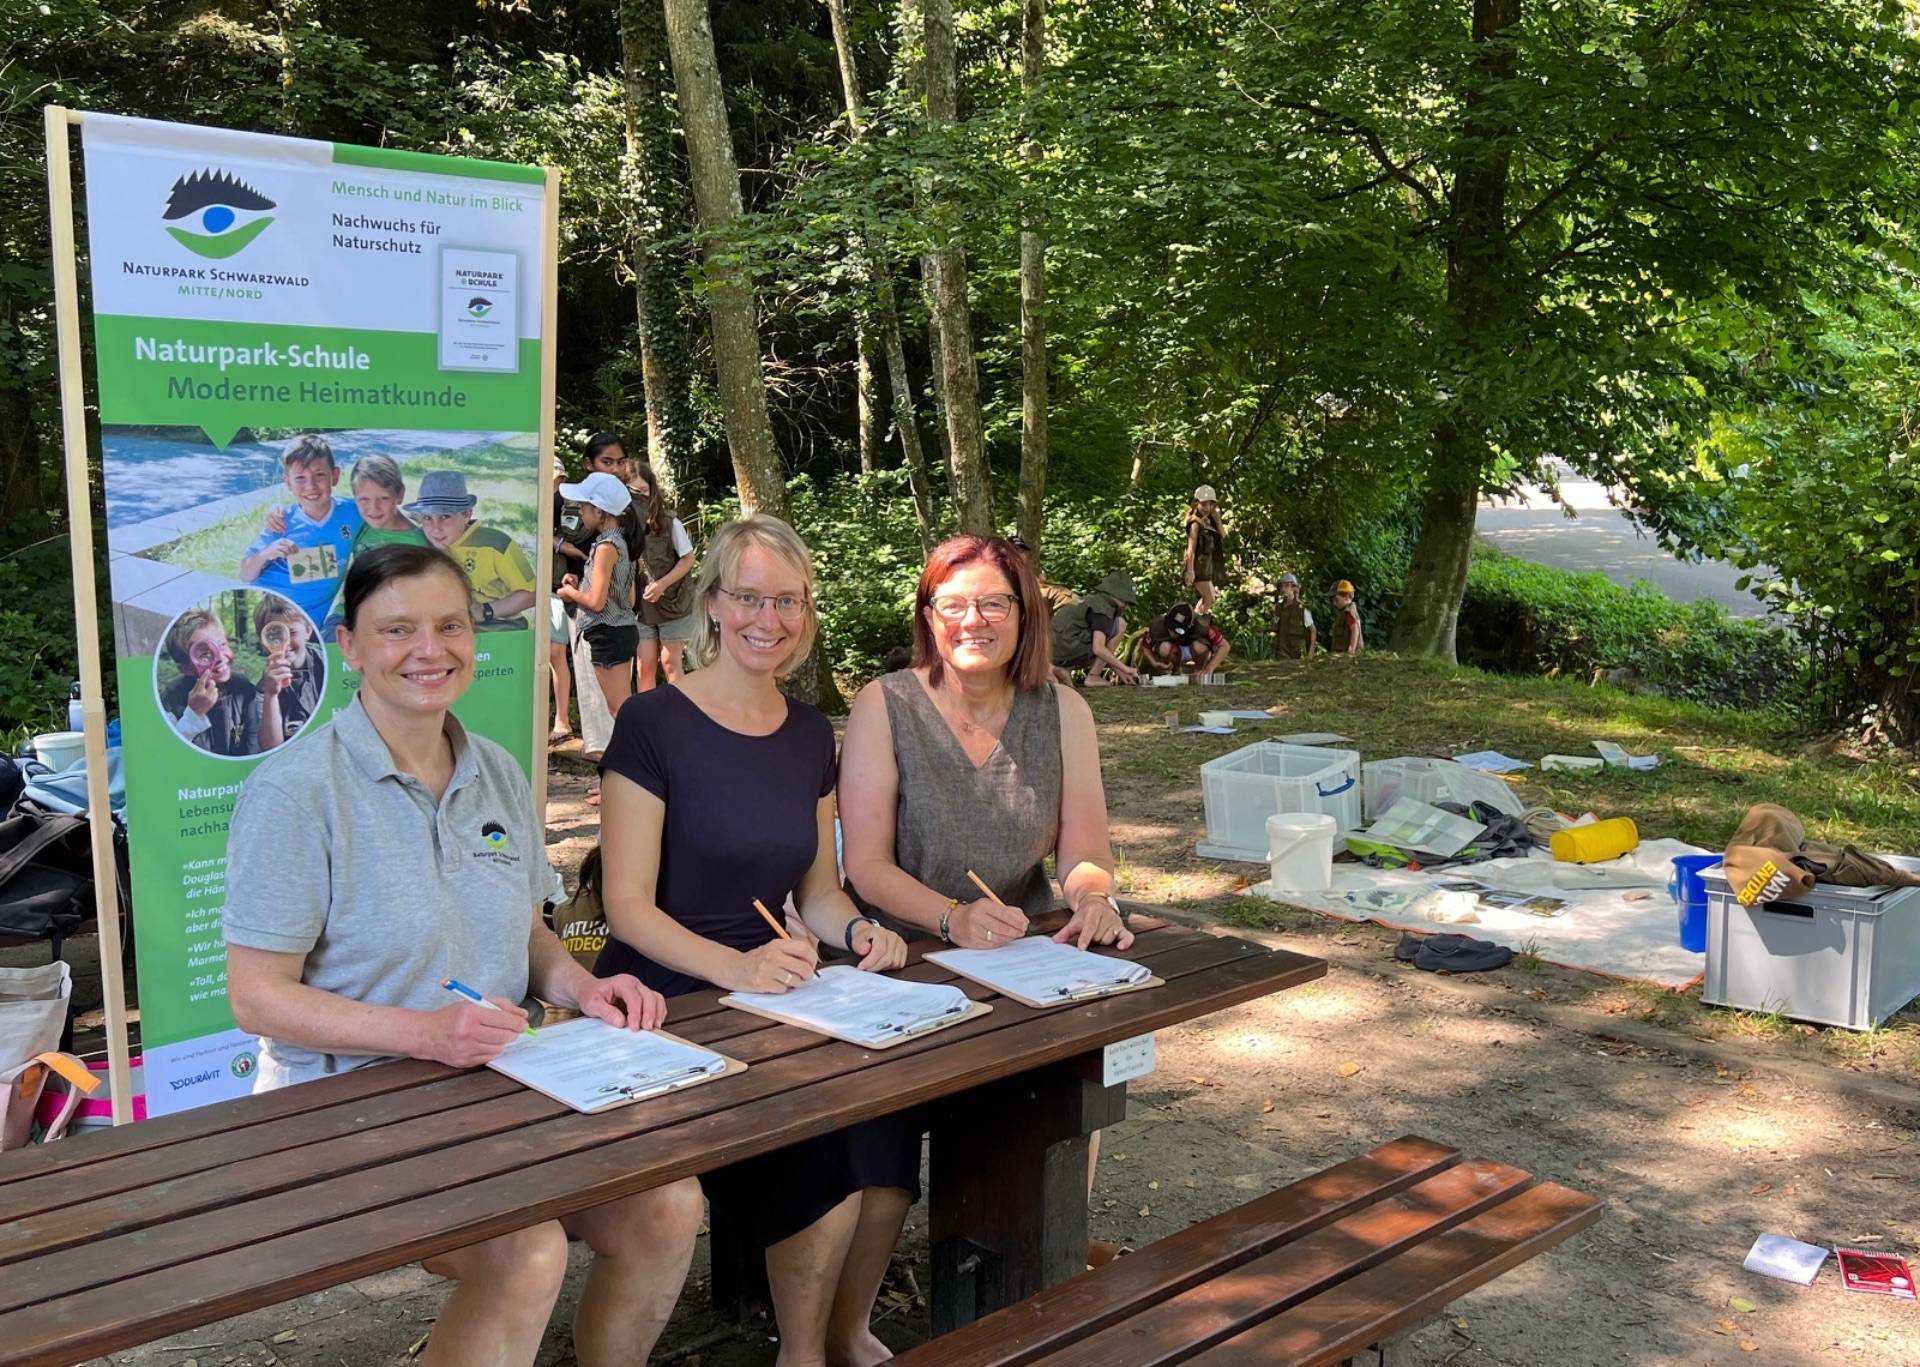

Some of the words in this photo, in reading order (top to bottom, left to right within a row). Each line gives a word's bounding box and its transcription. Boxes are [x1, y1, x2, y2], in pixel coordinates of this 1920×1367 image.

[332, 180, 389, 200] Mensch
[394, 184, 421, 202] und
[426, 188, 466, 207] Natur
[469, 192, 488, 208] im
[491, 194, 524, 213] Blick
[332, 213, 416, 234] Nachwuchs
[420, 219, 441, 235] für
[333, 234, 421, 254] Naturschutz
[123, 261, 206, 280] NATURPARK
[210, 267, 309, 287] SCHWARZWALD
[456, 269, 505, 280] NATURPARK
[468, 278, 498, 288] SCHULE
[178, 284, 263, 300] MITTE/NORD
[135, 336, 370, 370] Naturpark-Schule
[167, 376, 291, 402] Moderne
[299, 381, 467, 408] Heimatkunde
[186, 887, 202, 899] die
[185, 921, 210, 934] aber
[562, 920, 610, 939] ATUR
[190, 990, 209, 1002] wie
[184, 1069, 221, 1087] DURAVIT
